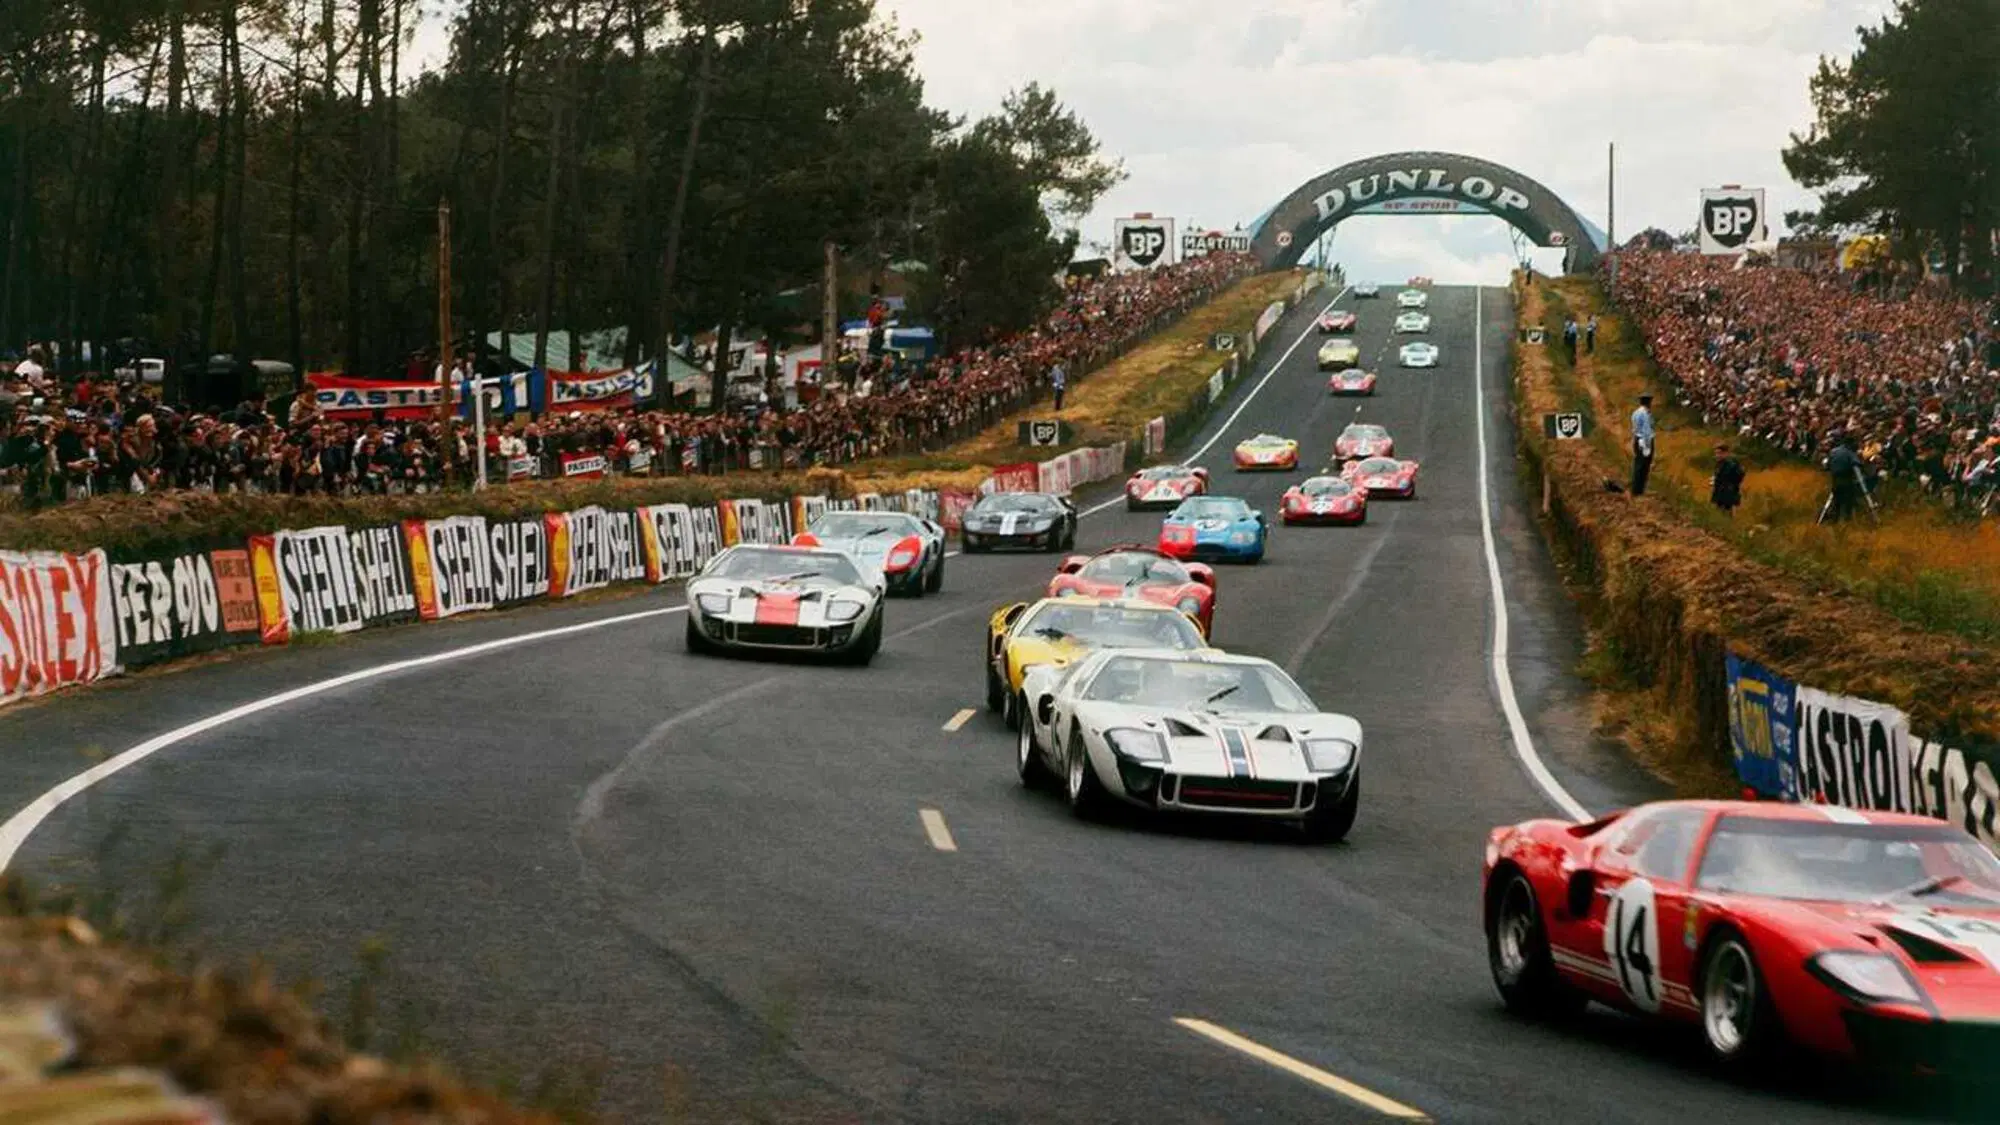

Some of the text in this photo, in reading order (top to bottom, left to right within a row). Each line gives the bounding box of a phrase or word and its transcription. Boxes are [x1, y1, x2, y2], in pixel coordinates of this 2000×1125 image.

[1312, 168, 1530, 222] DUNLOP
[1712, 205, 1754, 236] BP
[1129, 231, 1162, 257] BP
[1184, 236, 1248, 250] MARTINI
[554, 370, 636, 400] PASTIS
[1036, 425, 1055, 440] BP
[1561, 418, 1578, 432] BP
[280, 534, 359, 630] SHELL
[350, 525, 416, 620] SHELL
[1614, 897, 1658, 1002] 14
